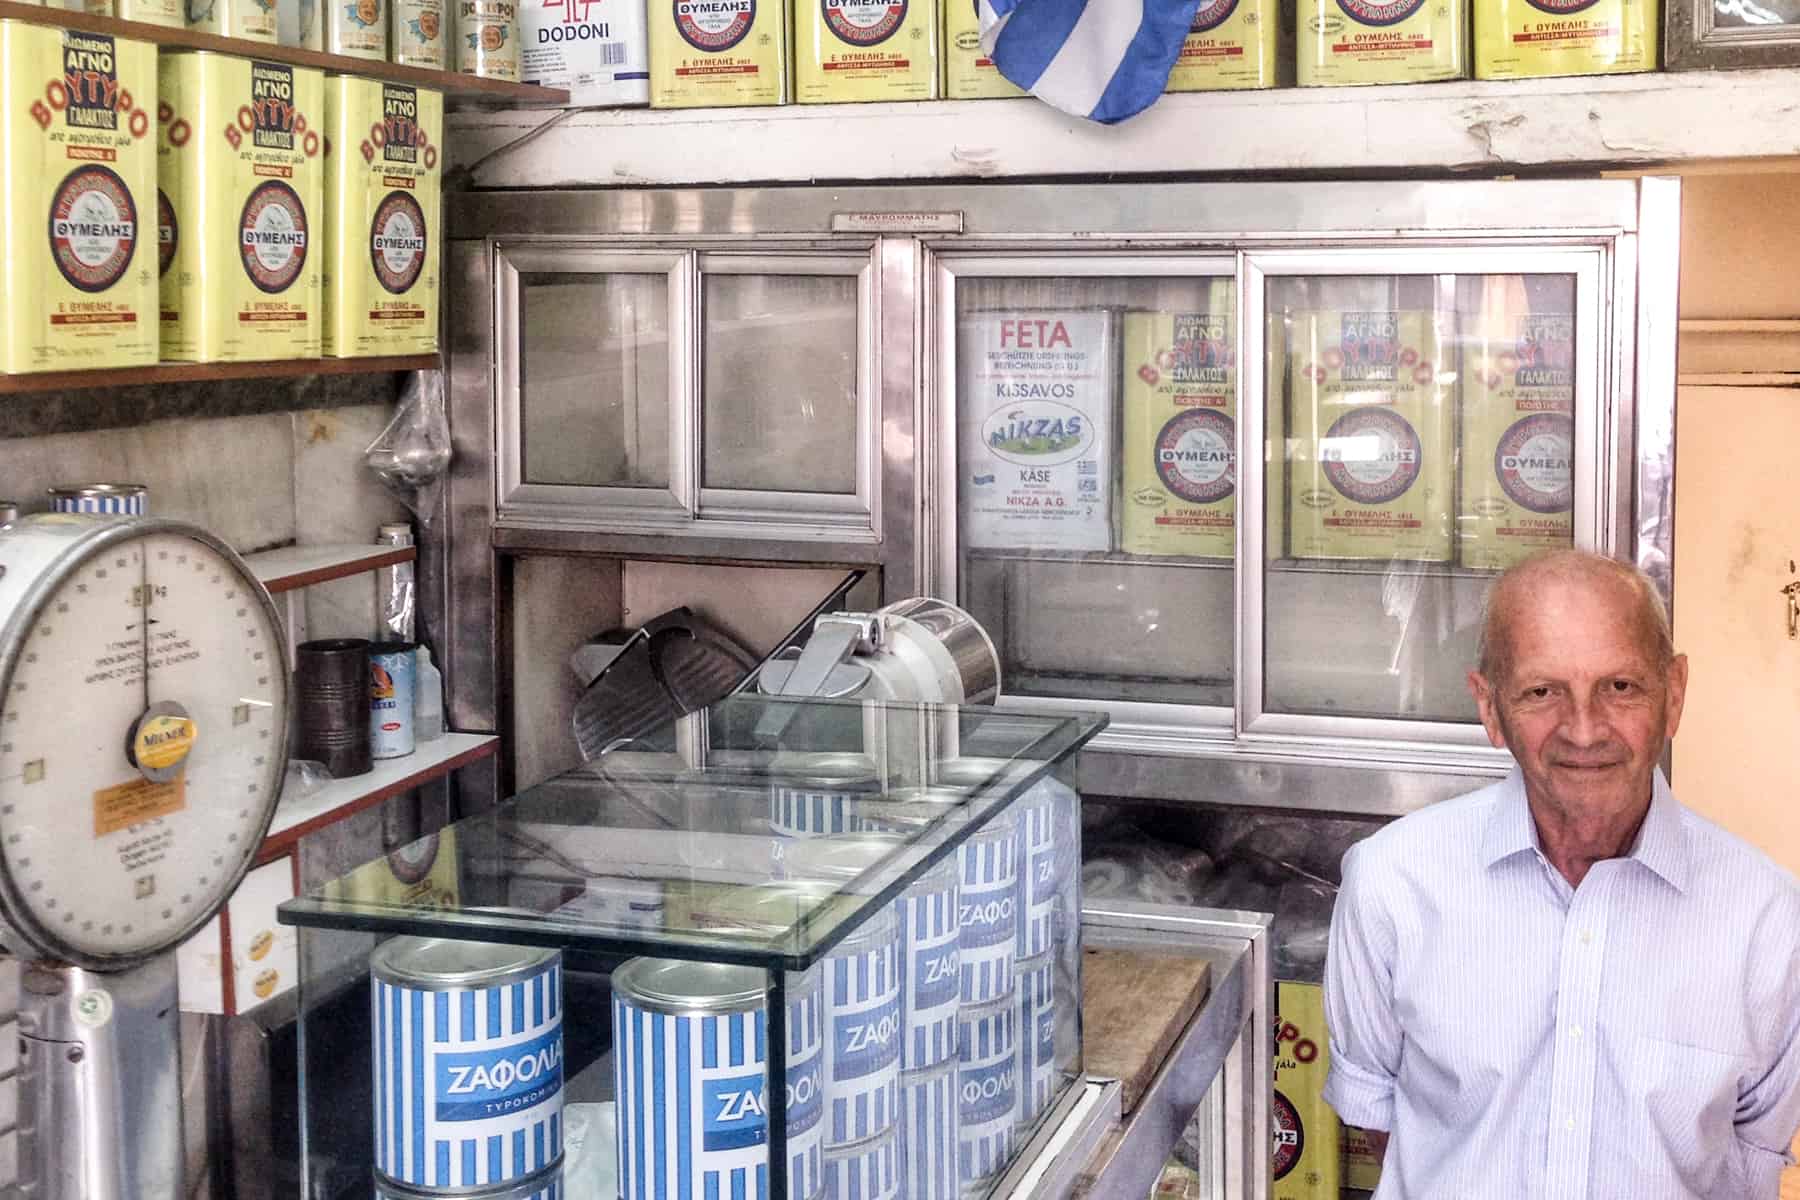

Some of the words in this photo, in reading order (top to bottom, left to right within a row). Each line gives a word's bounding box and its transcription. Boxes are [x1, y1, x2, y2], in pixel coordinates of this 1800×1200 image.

[681, 1, 749, 13] ΘΥΜΕΛΗΣ
[538, 23, 609, 43] DODONI
[67, 51, 113, 73] ΑΓΝΟ
[254, 80, 291, 99] ΑΓΝΟ
[30, 71, 149, 138] ΒΟΥΤΥΡΟ
[385, 100, 415, 116] ΑΓΝΟ
[224, 98, 319, 157] ΒΟΥΤΥΡΟ
[360, 116, 437, 169] ΒΟΥΤΥΡΟ
[57, 222, 131, 238] ΘΥΜΕΛΗΣ
[245, 231, 303, 244] ΘΥΜΕΛΗΣ
[375, 238, 423, 249] ΘΥΜΕΛΗΣ
[1000, 320, 1072, 348] FETA
[1178, 326, 1225, 341] ΑΓΝΟ
[1346, 320, 1395, 337] ΑΓΝΟ
[996, 383, 1075, 398] KISSAVOS
[1163, 451, 1234, 462] ΘΥΜΕΛΗ
[1006, 496, 1040, 507] NIKZA
